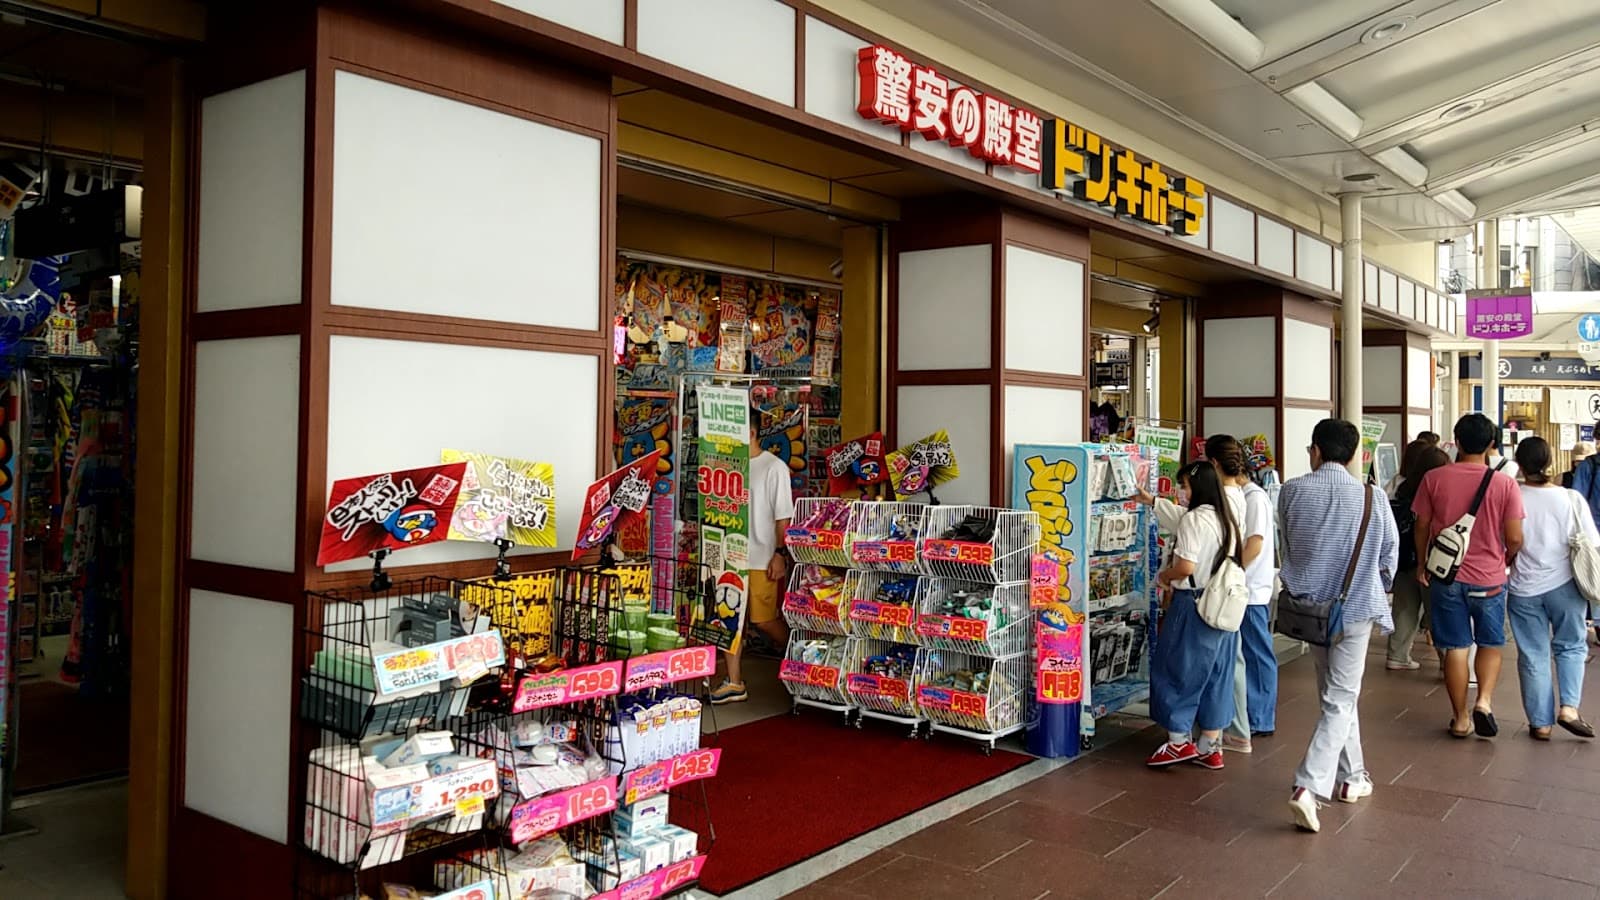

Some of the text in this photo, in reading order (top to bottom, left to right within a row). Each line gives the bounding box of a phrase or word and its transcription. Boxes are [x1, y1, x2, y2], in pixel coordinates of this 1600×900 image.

[874, 46, 1042, 172] 驚安の殿堂
[702, 401, 735, 422] LINE
[1137, 434, 1169, 447] LINE
[818, 531, 843, 548] 300
[1044, 671, 1081, 698] 798
